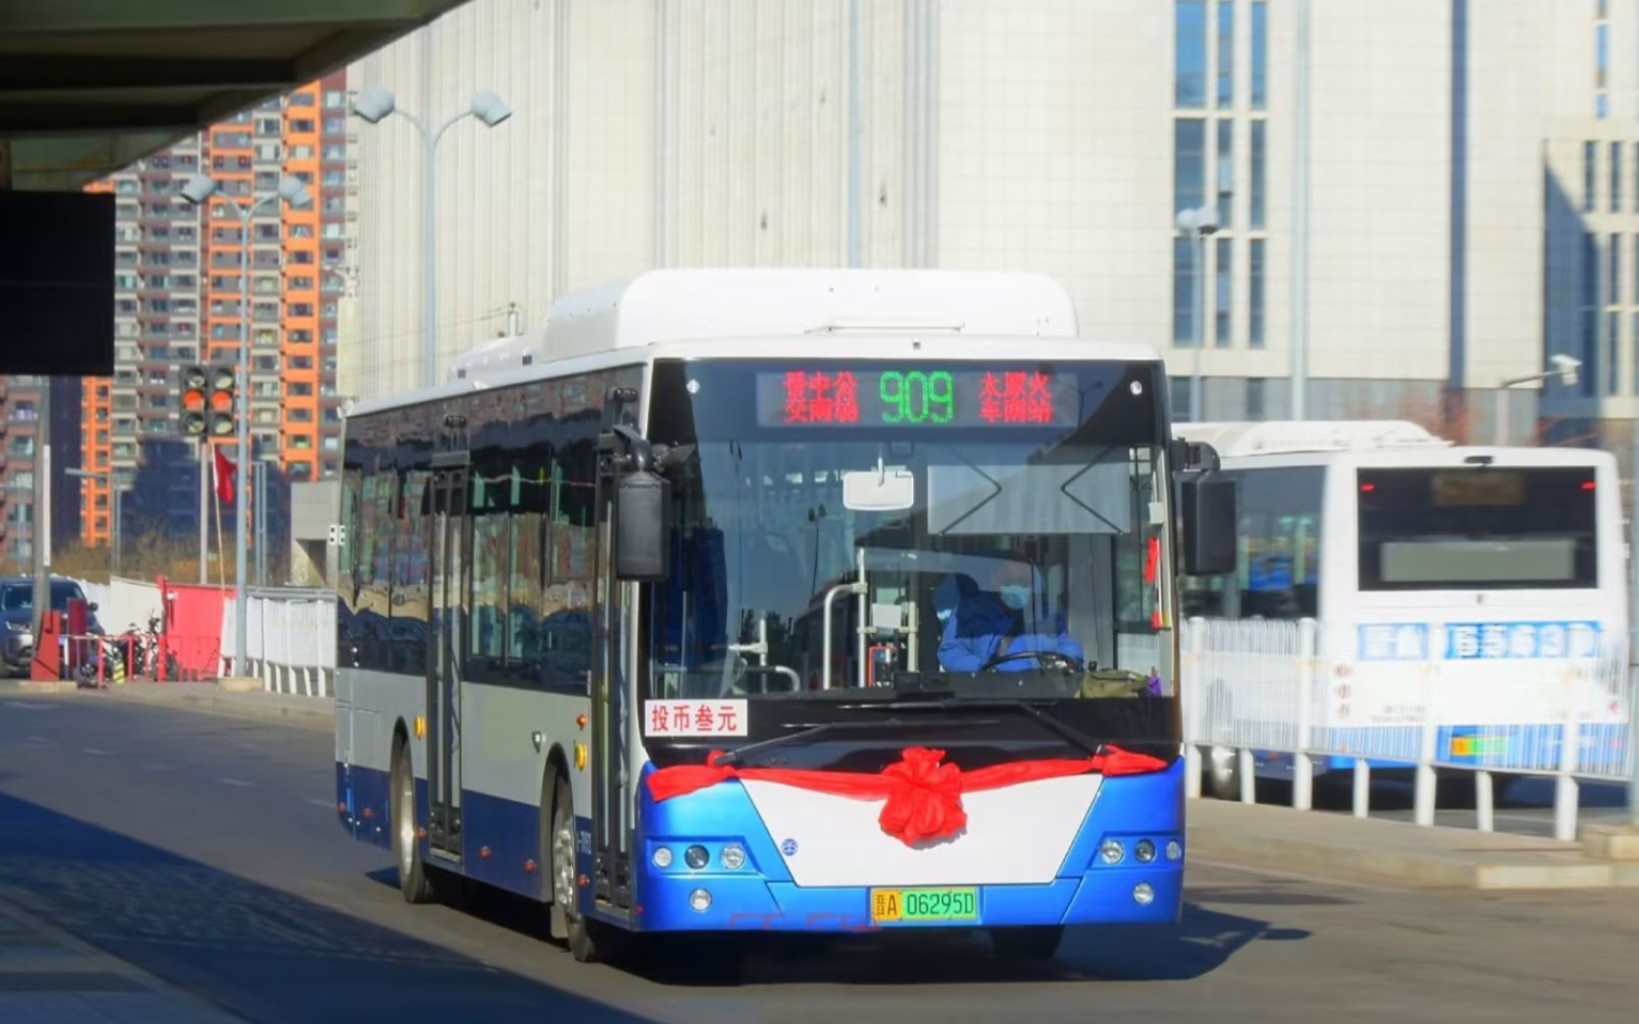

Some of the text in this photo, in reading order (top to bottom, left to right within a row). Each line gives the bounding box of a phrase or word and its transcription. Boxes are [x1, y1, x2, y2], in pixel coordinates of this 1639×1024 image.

[880, 370, 953, 423] 909
[652, 704, 737, 732] 投币叁元
[906, 893, 974, 915] 06295D
